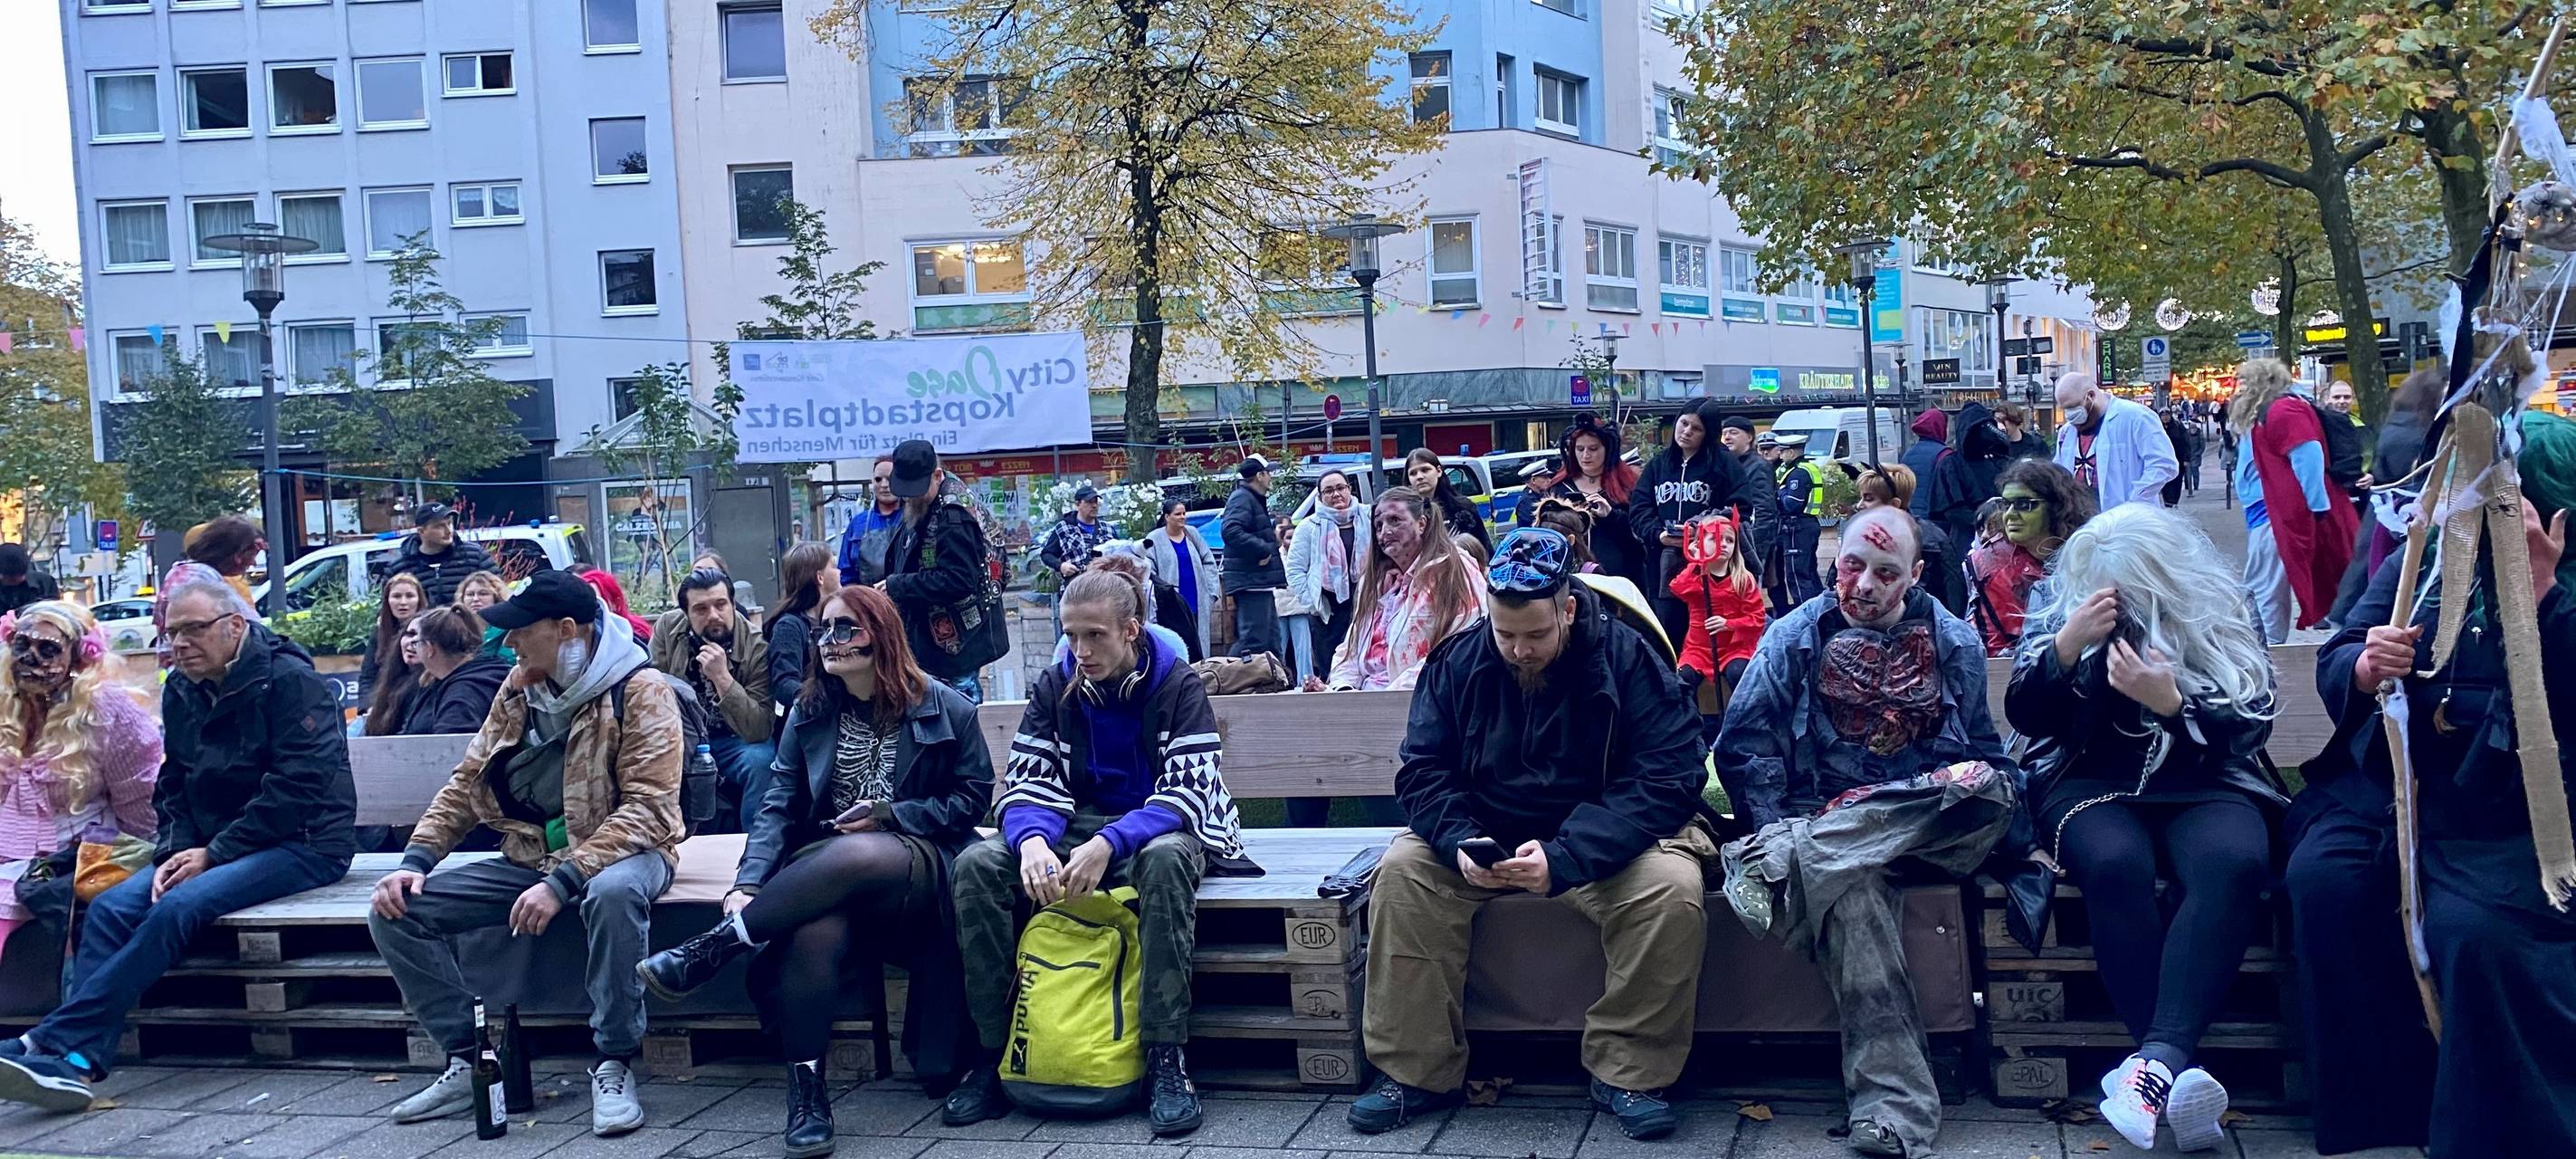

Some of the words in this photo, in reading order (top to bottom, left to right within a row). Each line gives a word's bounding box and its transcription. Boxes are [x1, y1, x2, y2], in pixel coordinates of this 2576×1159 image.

[2102, 340, 2113, 378] SHARM
[1798, 369, 1854, 389] KRÄUTERHAUS
[1301, 926, 1326, 944] EUR
[1016, 970, 1039, 1033] PUMA
[1313, 1058, 1340, 1076] EUR
